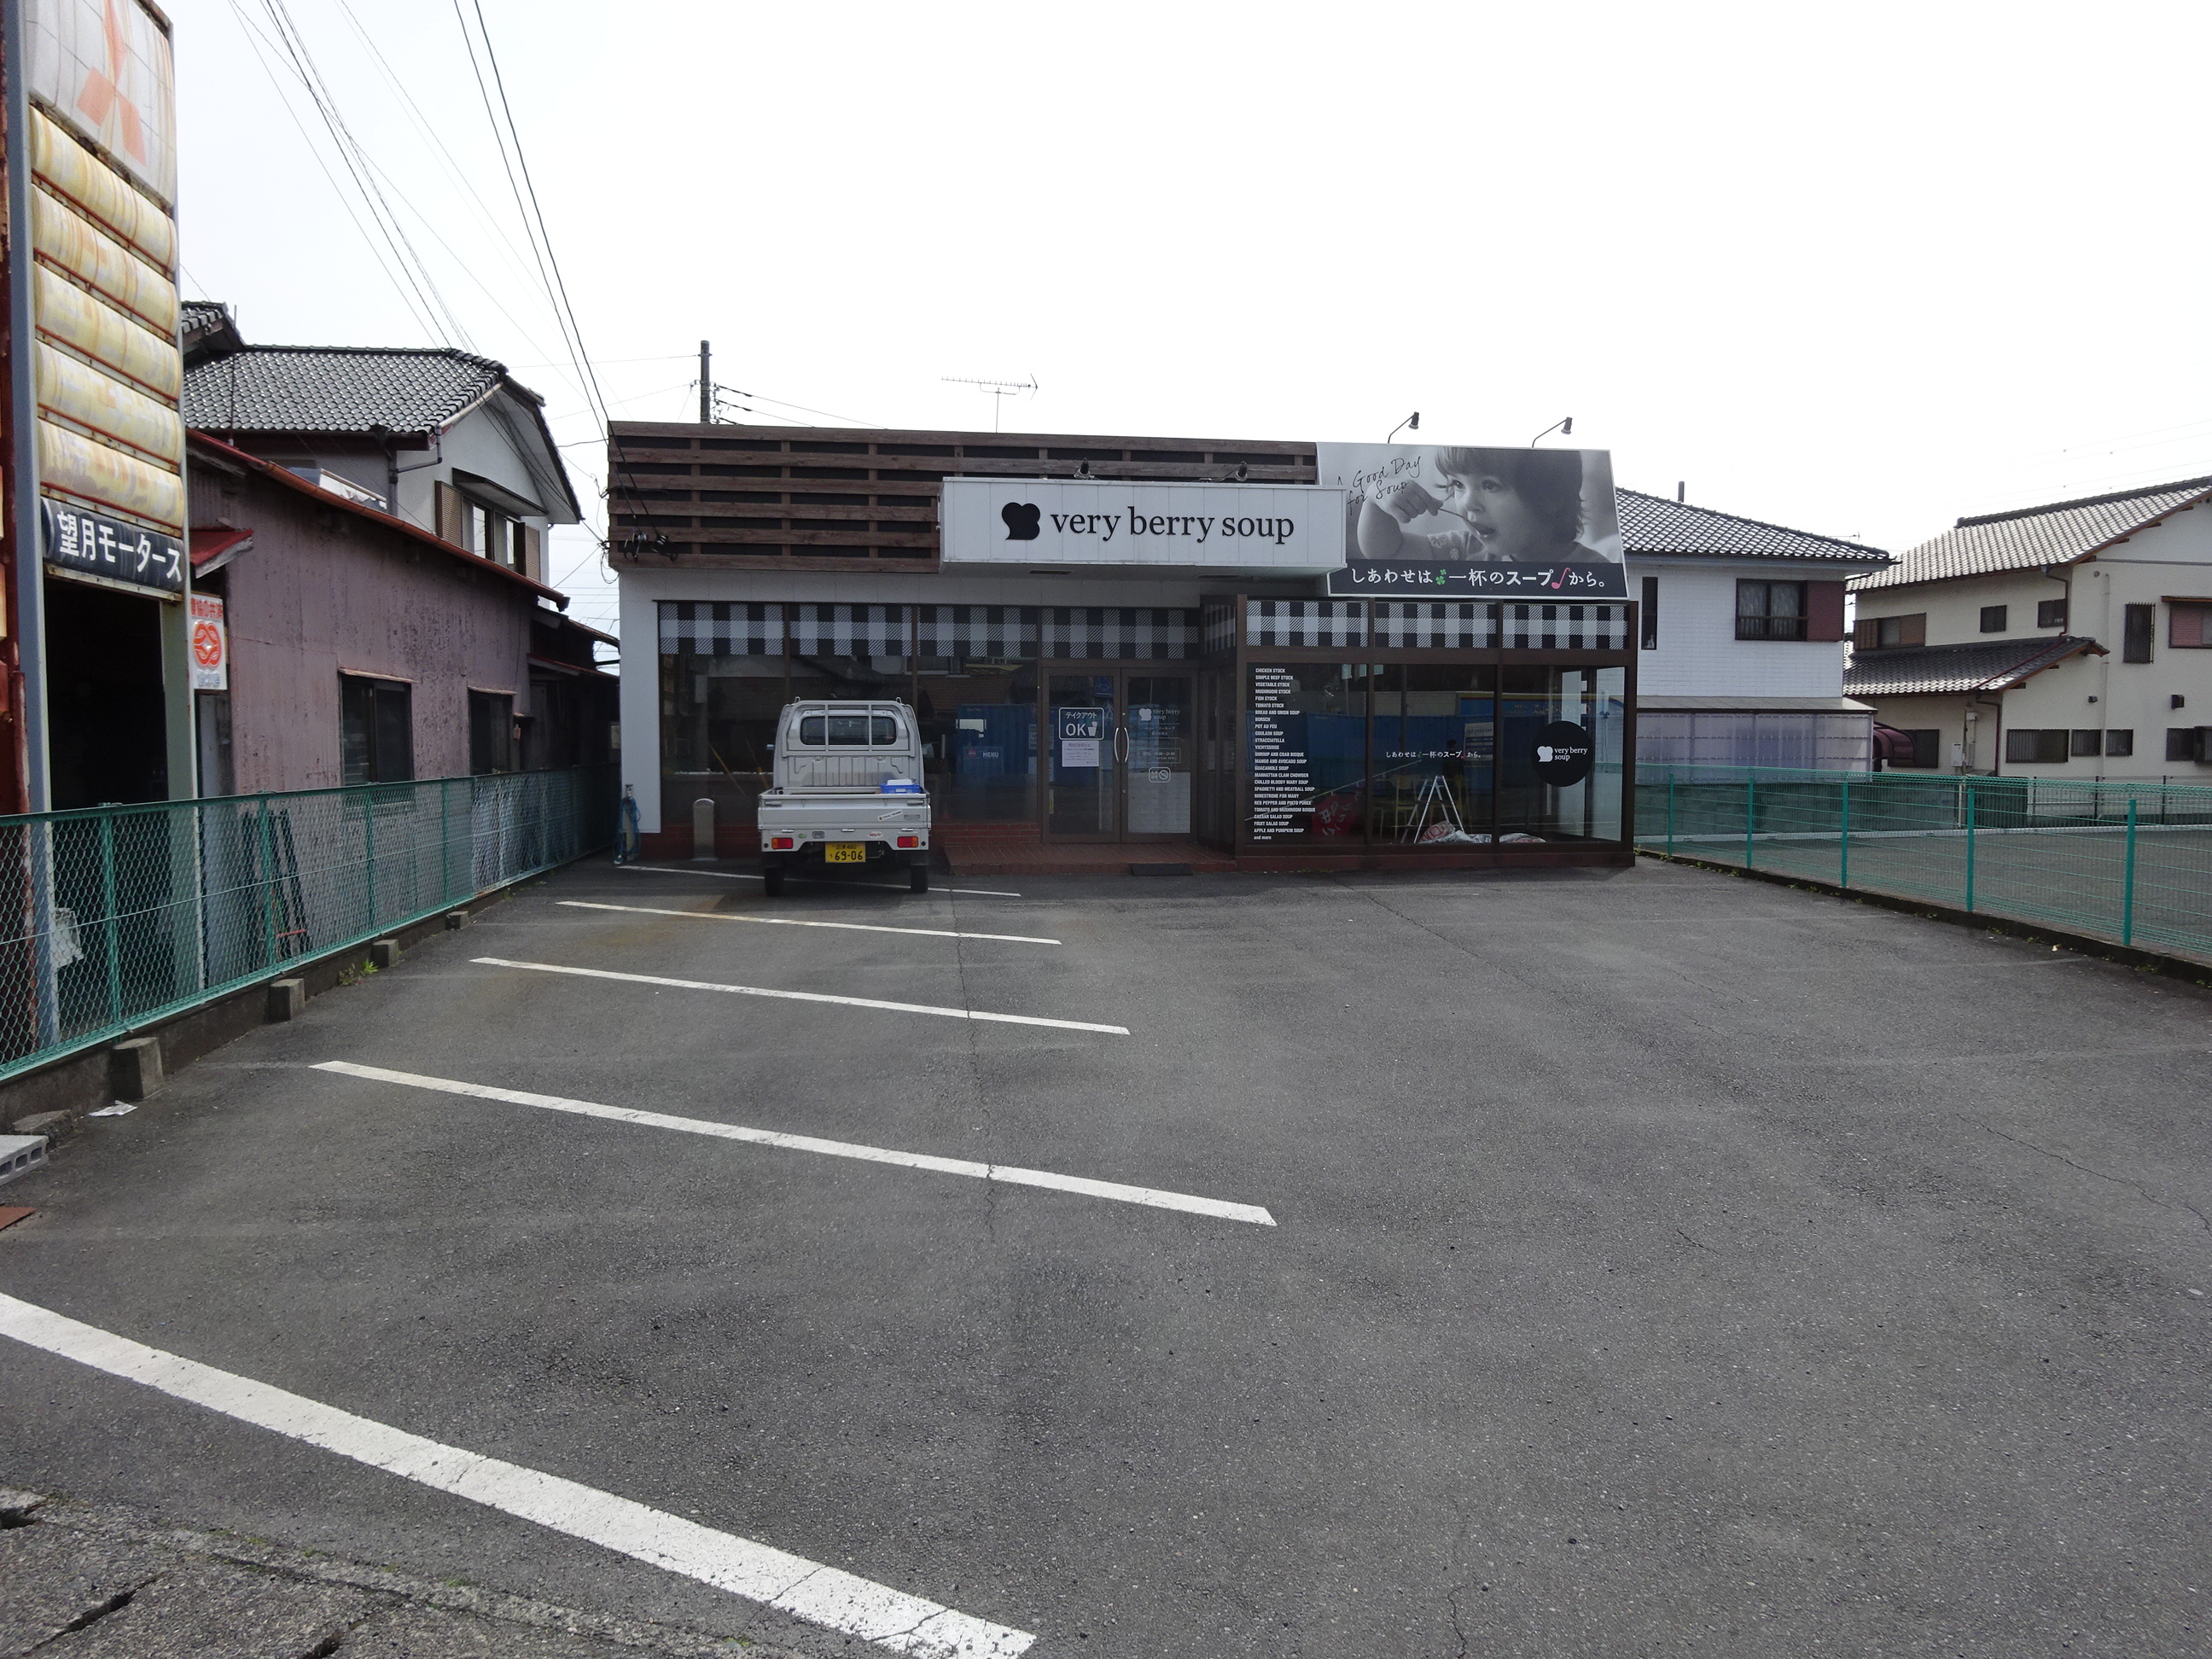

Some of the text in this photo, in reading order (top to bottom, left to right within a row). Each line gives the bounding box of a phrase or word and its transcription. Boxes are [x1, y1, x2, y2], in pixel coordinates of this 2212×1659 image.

[1353, 466, 1388, 493] Good
[1391, 457, 1421, 479] Day
[1348, 480, 1410, 516] for Soup
[1051, 505, 1295, 544] very berry soup
[57, 510, 182, 582] 望月モータース
[1066, 723, 1086, 736] OK
[1554, 746, 1588, 755] very berry
[835, 851, 864, 861] 69-06
